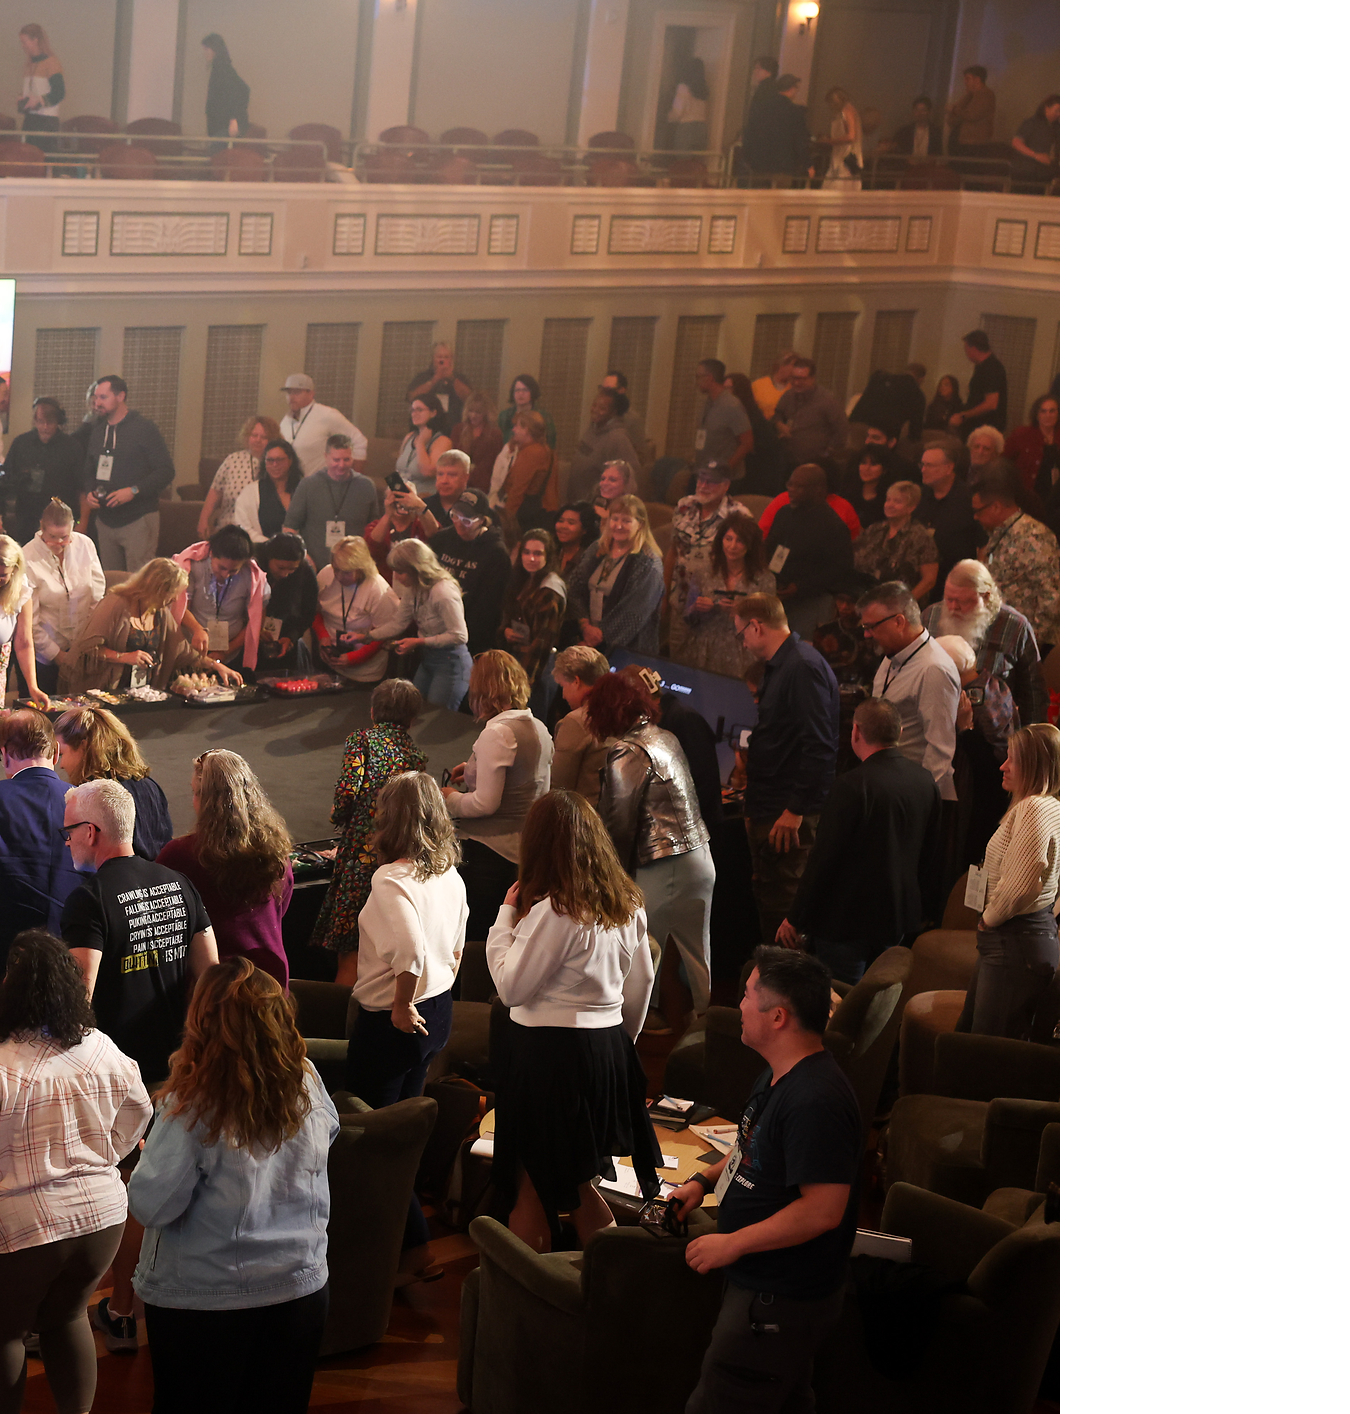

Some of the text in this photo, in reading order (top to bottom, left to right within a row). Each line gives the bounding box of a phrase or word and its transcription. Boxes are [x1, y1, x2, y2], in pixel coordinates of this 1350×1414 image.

[149, 881, 182, 897] ACCEPTABLE
[150, 894, 184, 910] ACCEPTABLE
[151, 907, 187, 923] ACCEPTABLE
[154, 920, 188, 936] ACCEPTABLE
[133, 941, 146, 953] PAIN
[153, 933, 184, 950] CCEPTABLE
[165, 949, 173, 963] IS
